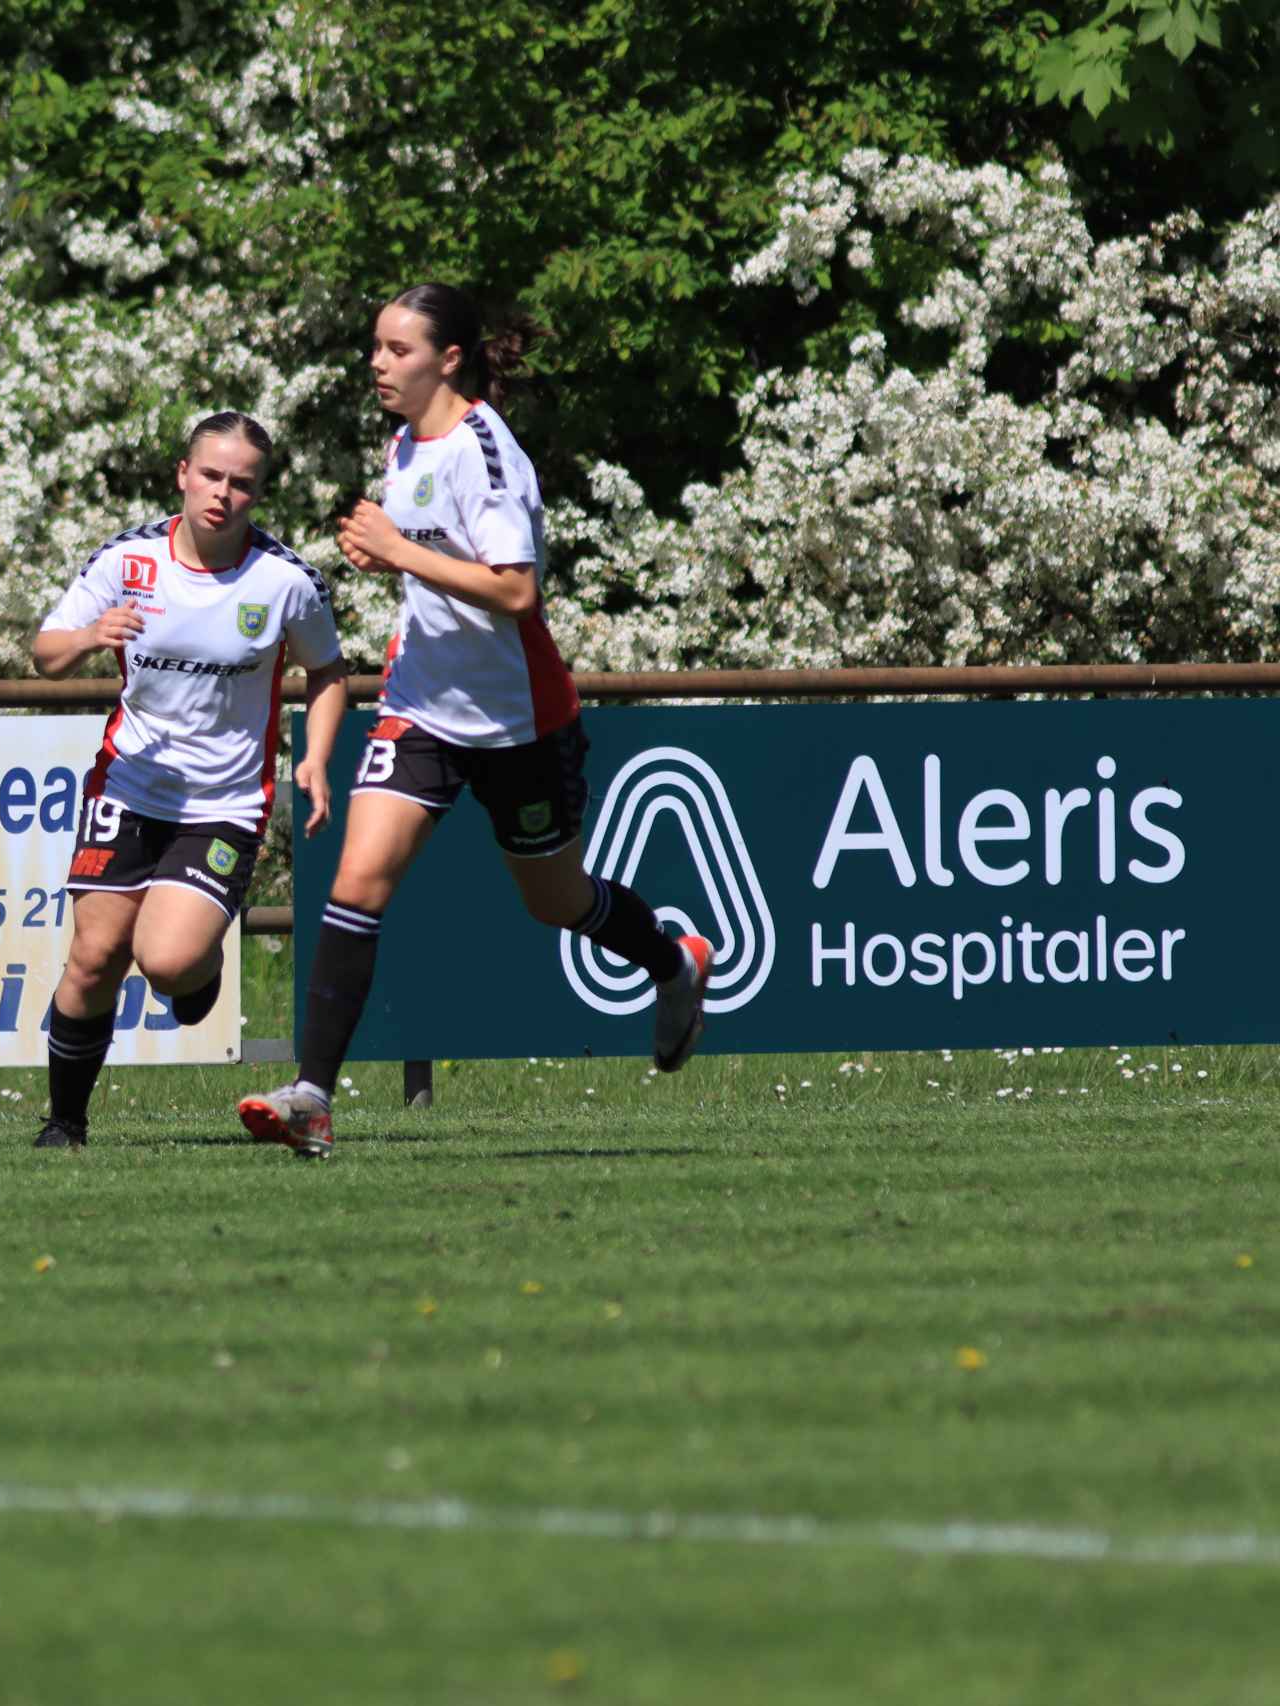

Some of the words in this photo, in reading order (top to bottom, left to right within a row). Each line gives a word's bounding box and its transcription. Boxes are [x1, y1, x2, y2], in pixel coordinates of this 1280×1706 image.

[83, 797, 122, 842] 19
[812, 754, 1186, 889] Aleris
[22, 887, 67, 928] 21
[812, 915, 1186, 1000] Hospitaler
